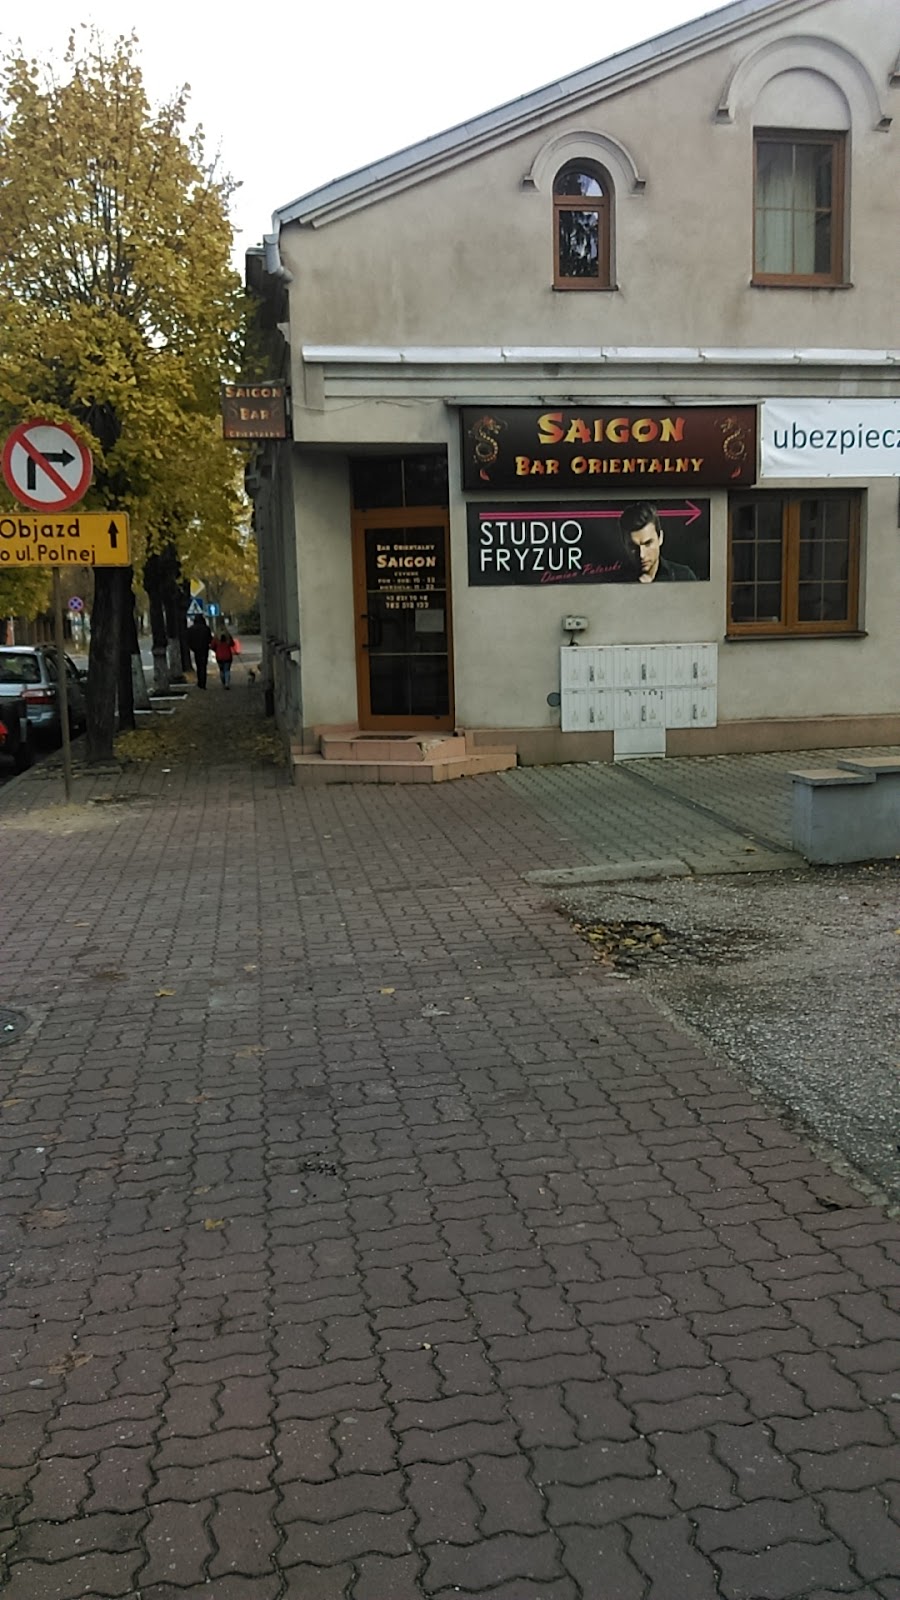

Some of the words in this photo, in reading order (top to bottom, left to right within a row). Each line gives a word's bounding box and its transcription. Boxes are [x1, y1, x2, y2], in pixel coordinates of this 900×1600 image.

[225, 386, 282, 398] SAIGON
[240, 407, 270, 421] BAR
[536, 412, 686, 445] SAIGON
[514, 456, 561, 476] BAR
[571, 456, 706, 475] ORIENTALNY
[0, 518, 80, 543] Objazd
[480, 520, 583, 545] STUDIO
[376, 554, 436, 568] SAIGON
[480, 547, 583, 572] FRYZUR
